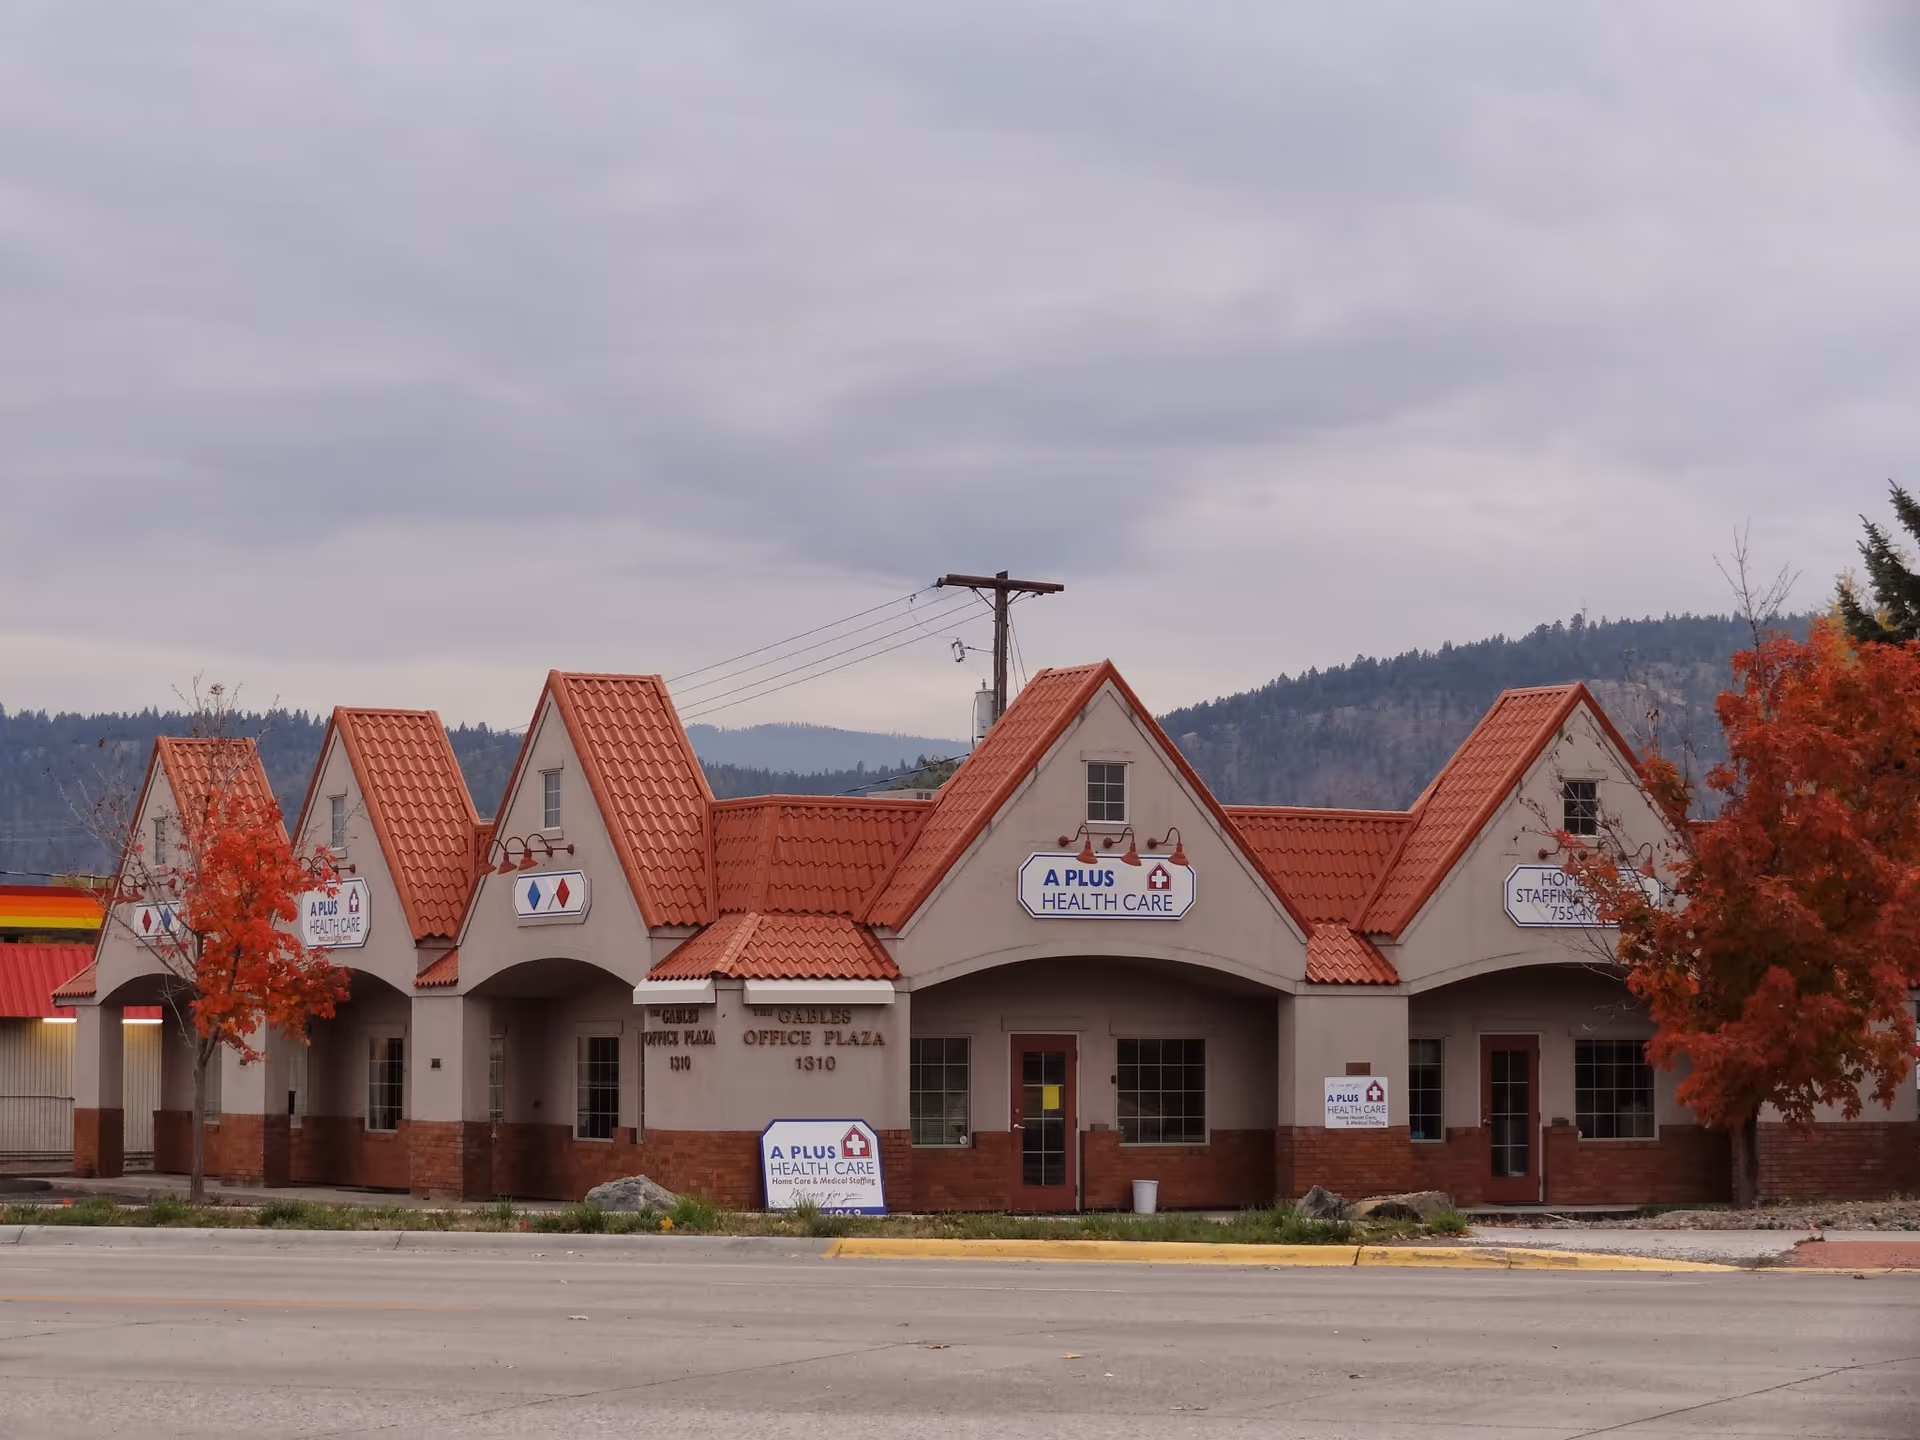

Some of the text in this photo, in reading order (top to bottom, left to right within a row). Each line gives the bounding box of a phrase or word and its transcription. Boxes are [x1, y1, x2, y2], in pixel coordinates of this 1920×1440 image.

[1043, 869, 1115, 888] A PLUS
[310, 900, 338, 917] A PLUS
[1042, 893, 1173, 912] HEALTH CARE
[310, 917, 361, 935] HEALTH CARE
[778, 1009, 852, 1024] GABLES
[684, 1030, 716, 1045] PLAZA
[743, 1030, 886, 1046] OFFICE PLAZA
[669, 1056, 692, 1071] 1310
[795, 1056, 837, 1071] 1310
[1327, 1094, 1359, 1103] A PLUS
[1327, 1105, 1387, 1115] HEALTH CARE
[770, 1145, 837, 1160] A PLUS
[770, 1161, 875, 1176] HEALTH CARE
[771, 1176, 876, 1186] Home Care & Medical Staffing
